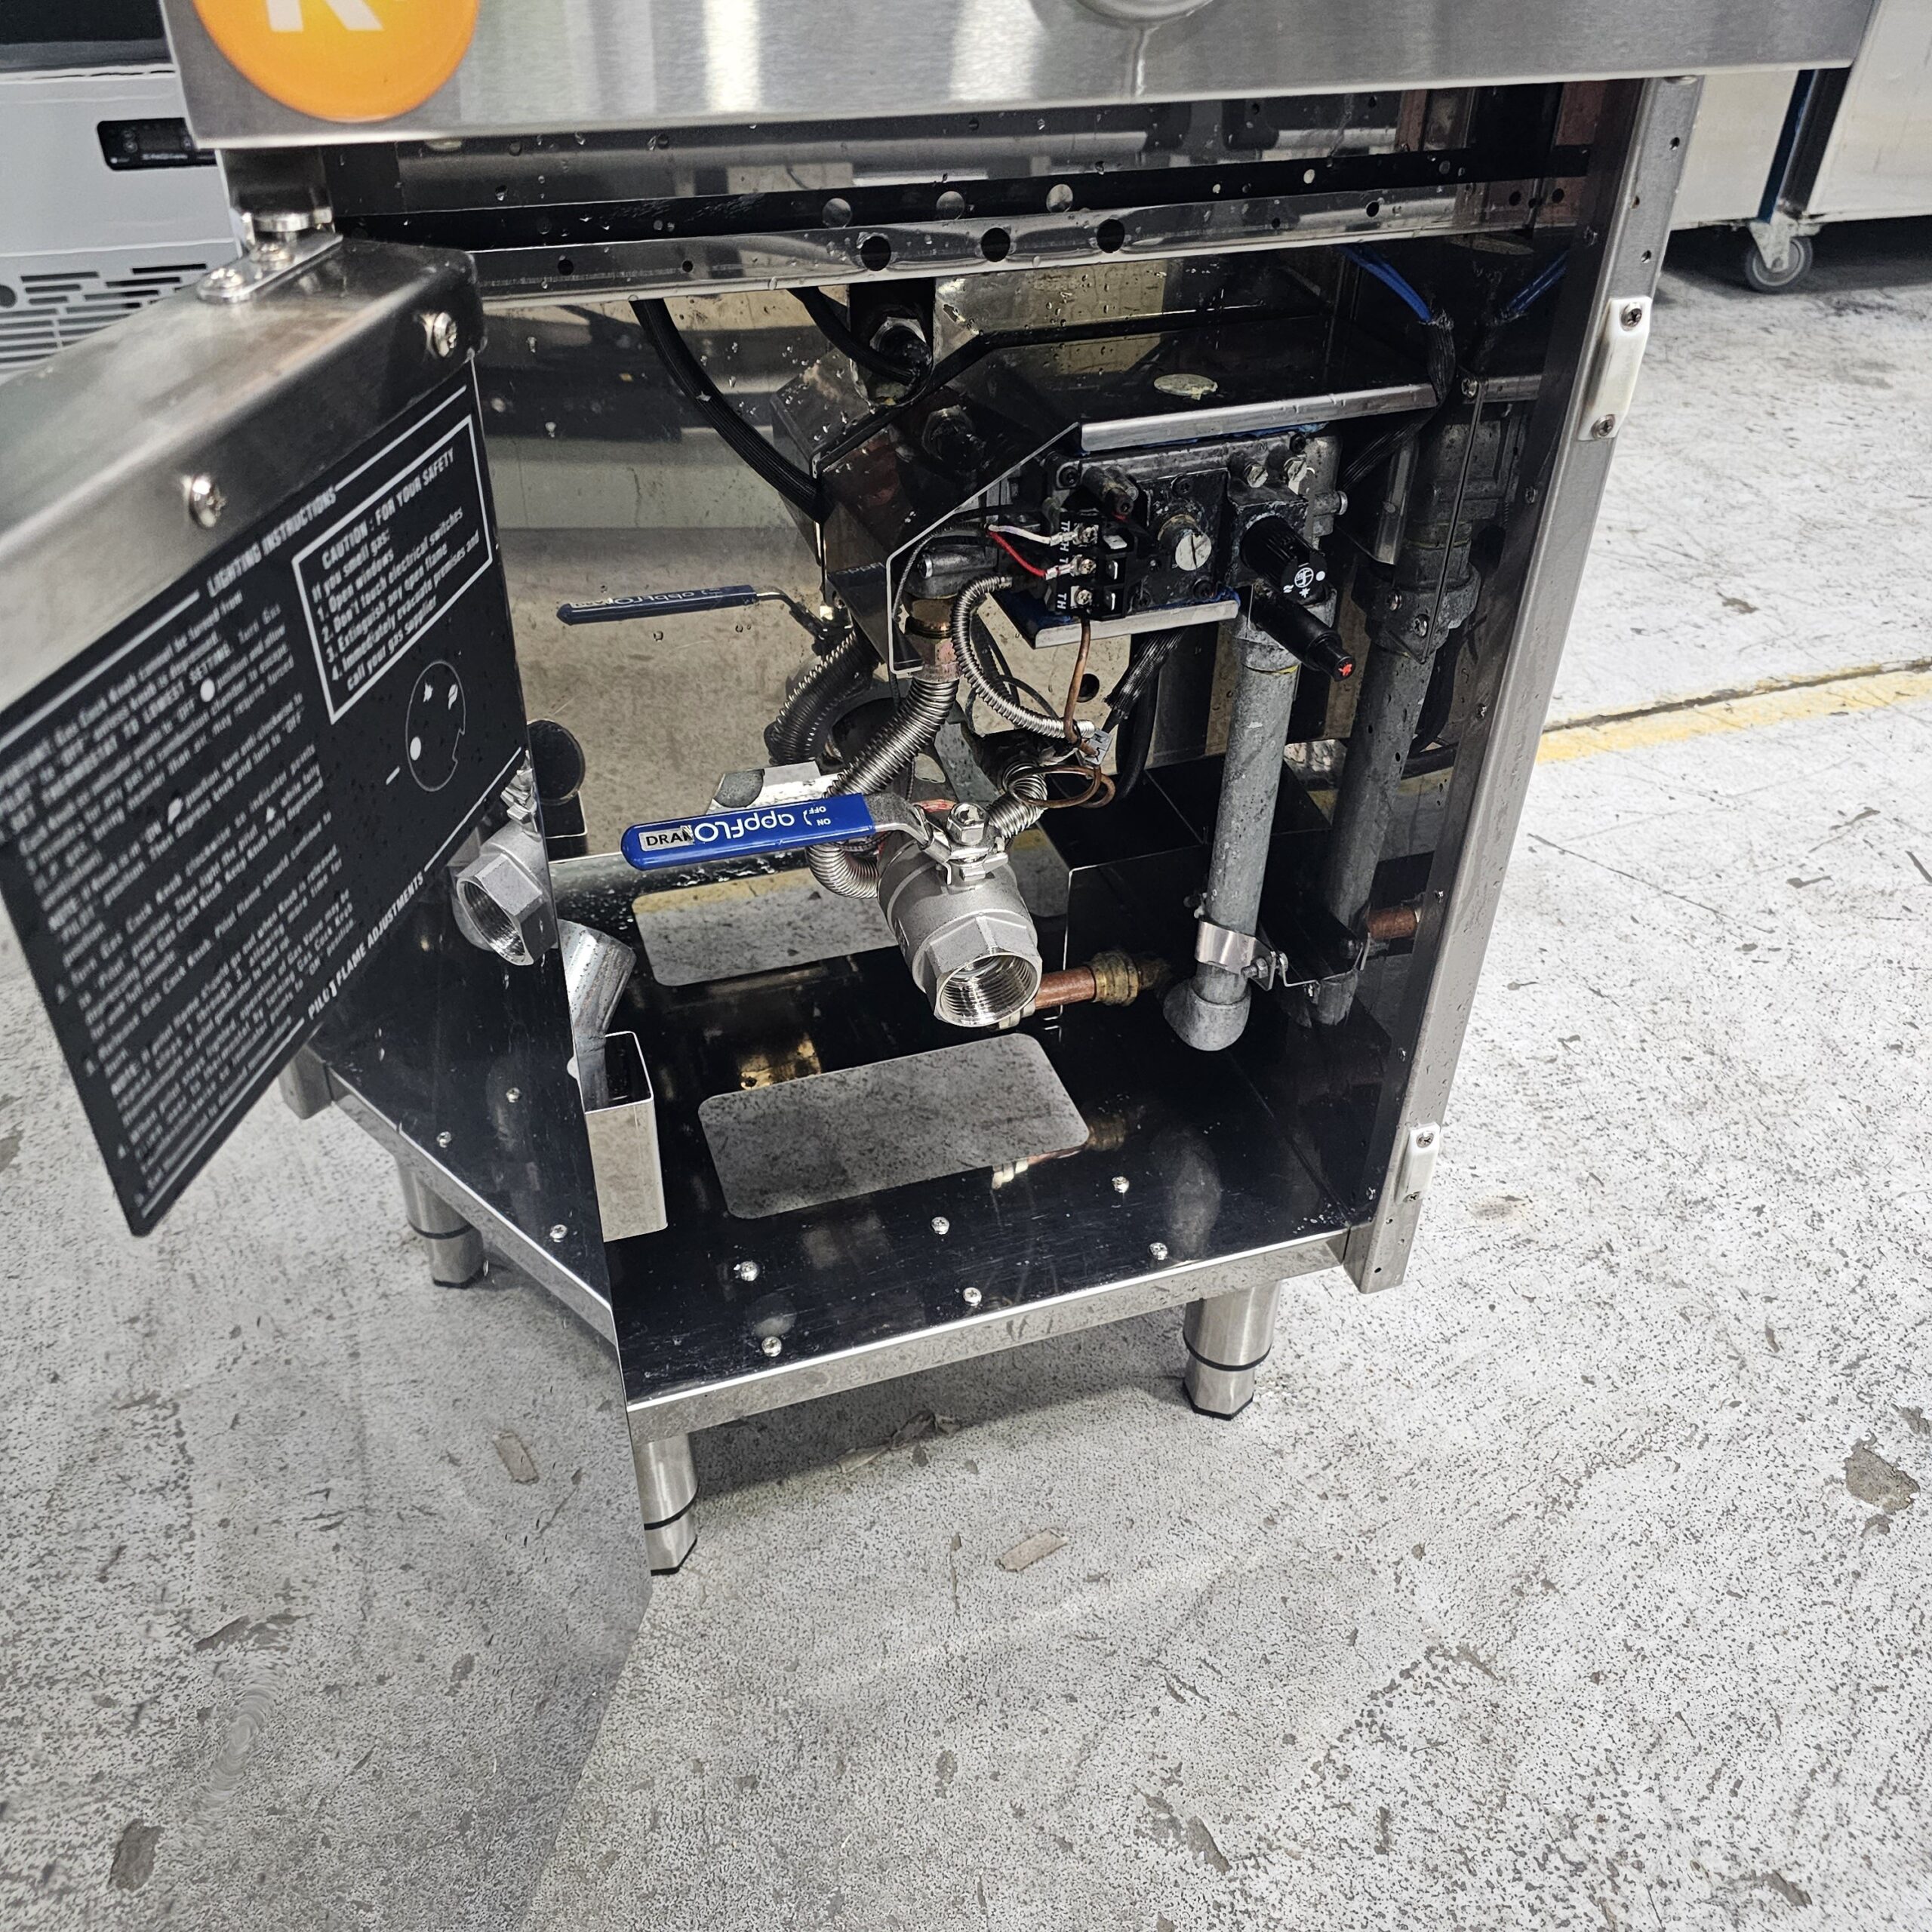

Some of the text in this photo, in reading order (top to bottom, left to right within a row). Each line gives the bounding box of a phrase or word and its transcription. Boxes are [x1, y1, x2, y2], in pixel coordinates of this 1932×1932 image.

[207, 486, 336, 597] LIGHTING INSTRUCTIONS
[321, 520, 368, 569] CAUTION
[374, 497, 395, 525] FOR
[395, 475, 421, 506] YOUR
[422, 447, 453, 485] SAFETY
[317, 548, 394, 621] 1. Open windows
[321, 625, 333, 643] 2.
[360, 576, 386, 608] touch
[388, 536, 428, 583] electrical
[429, 506, 463, 546] switches
[323, 570, 342, 596] you
[343, 543, 369, 577] smell
[326, 543, 447, 663] 3. Extinguish any open flame
[332, 529, 479, 680] 4. Immediately evacuate premises and
[1057, 592, 1067, 610] TH
[346, 595, 436, 691] call your gas supplier
[694, 811, 795, 842] appFLO
[808, 805, 826, 815] OFF
[817, 817, 831, 826] ON
[336, 942, 366, 986] FLAME
[367, 871, 423, 949] ADJUSTMENTS
